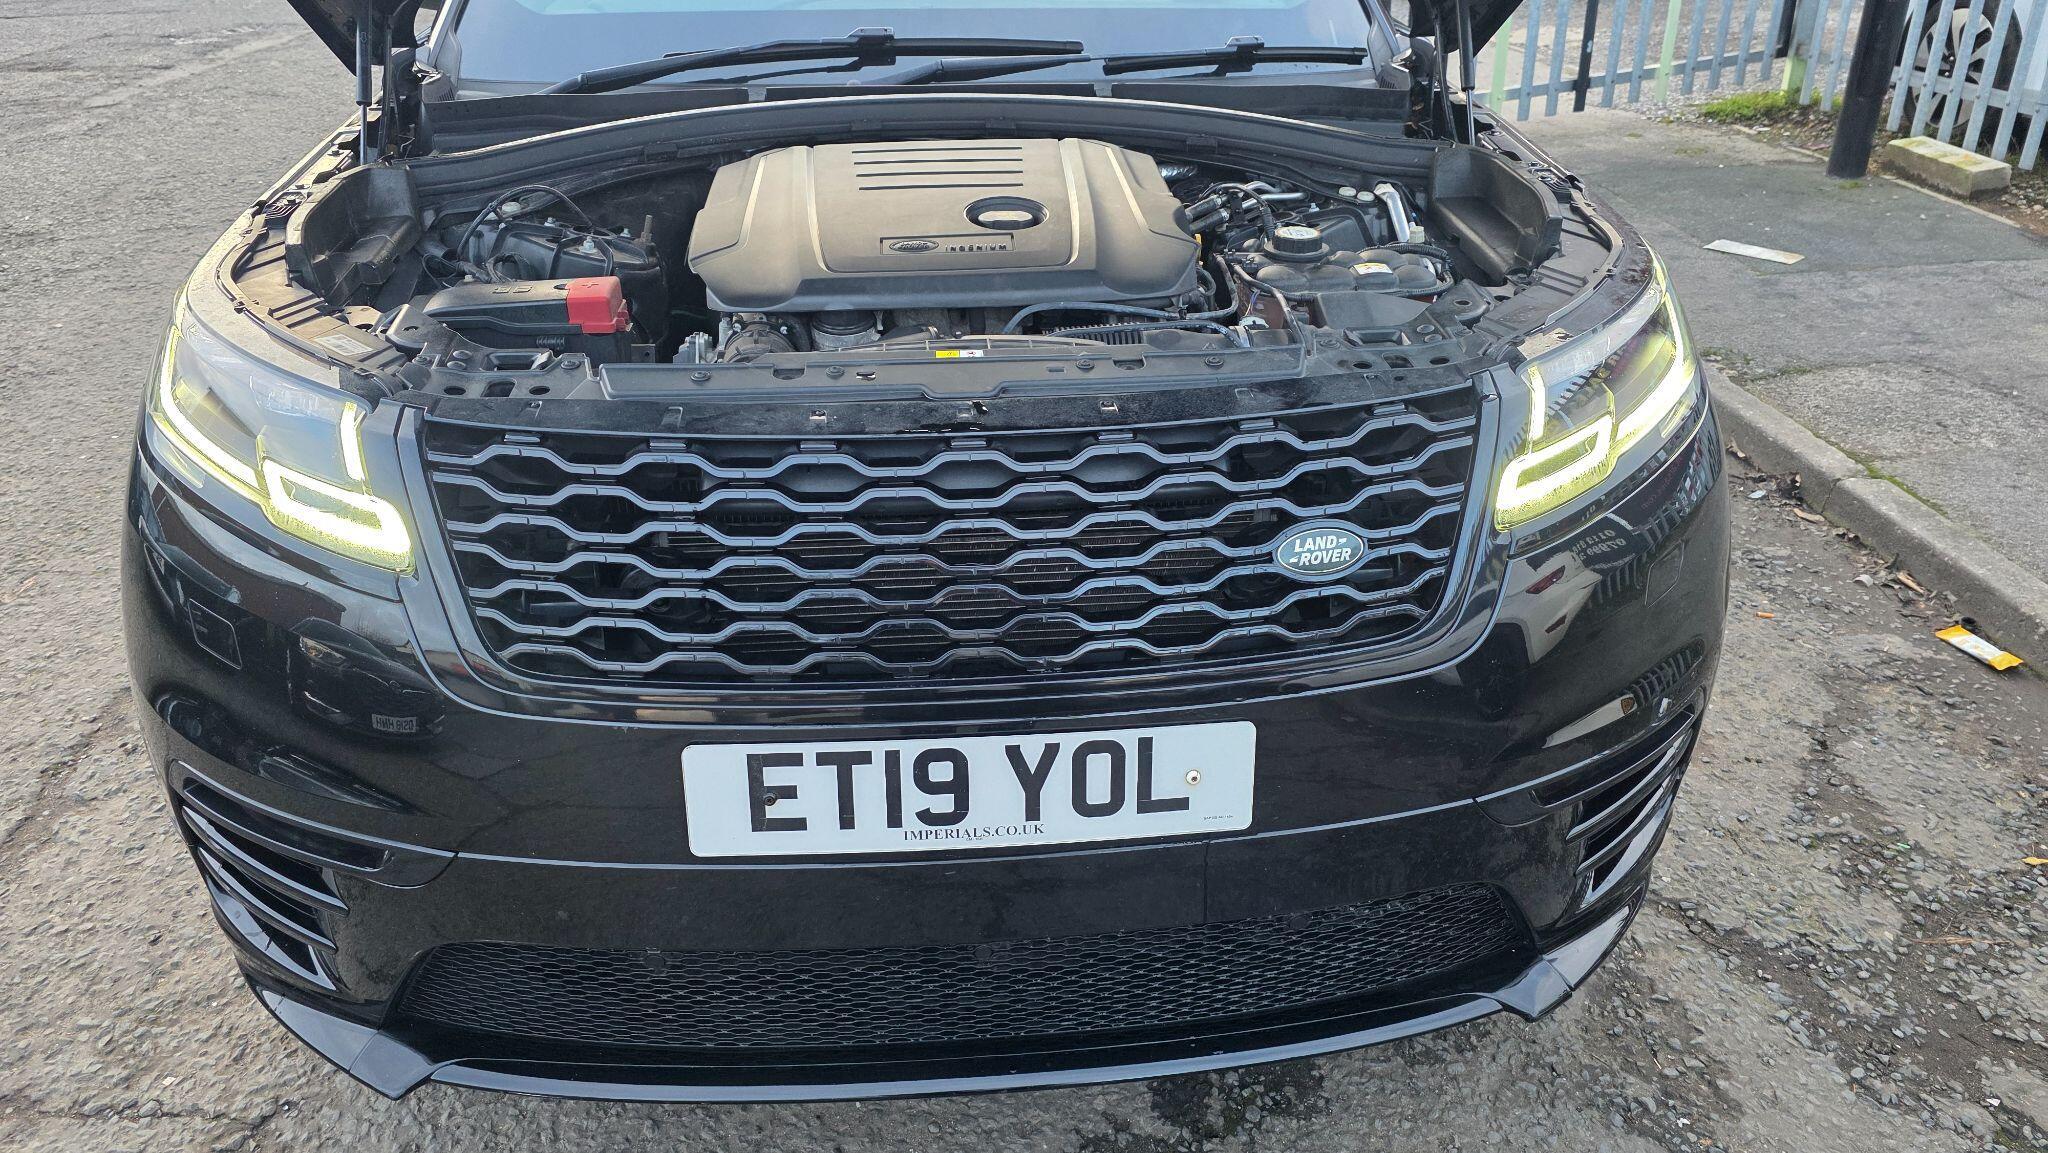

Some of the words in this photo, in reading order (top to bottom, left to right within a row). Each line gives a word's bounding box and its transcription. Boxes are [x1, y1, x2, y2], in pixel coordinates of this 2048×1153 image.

[945, 243, 1007, 252] INGENIUM
[1294, 535, 1338, 552] LAND
[1298, 547, 1352, 566] ROVER
[746, 747, 969, 832] ET19
[1005, 736, 1189, 822] YOL
[904, 823, 1045, 841] IMPERIALS.CO.UK
